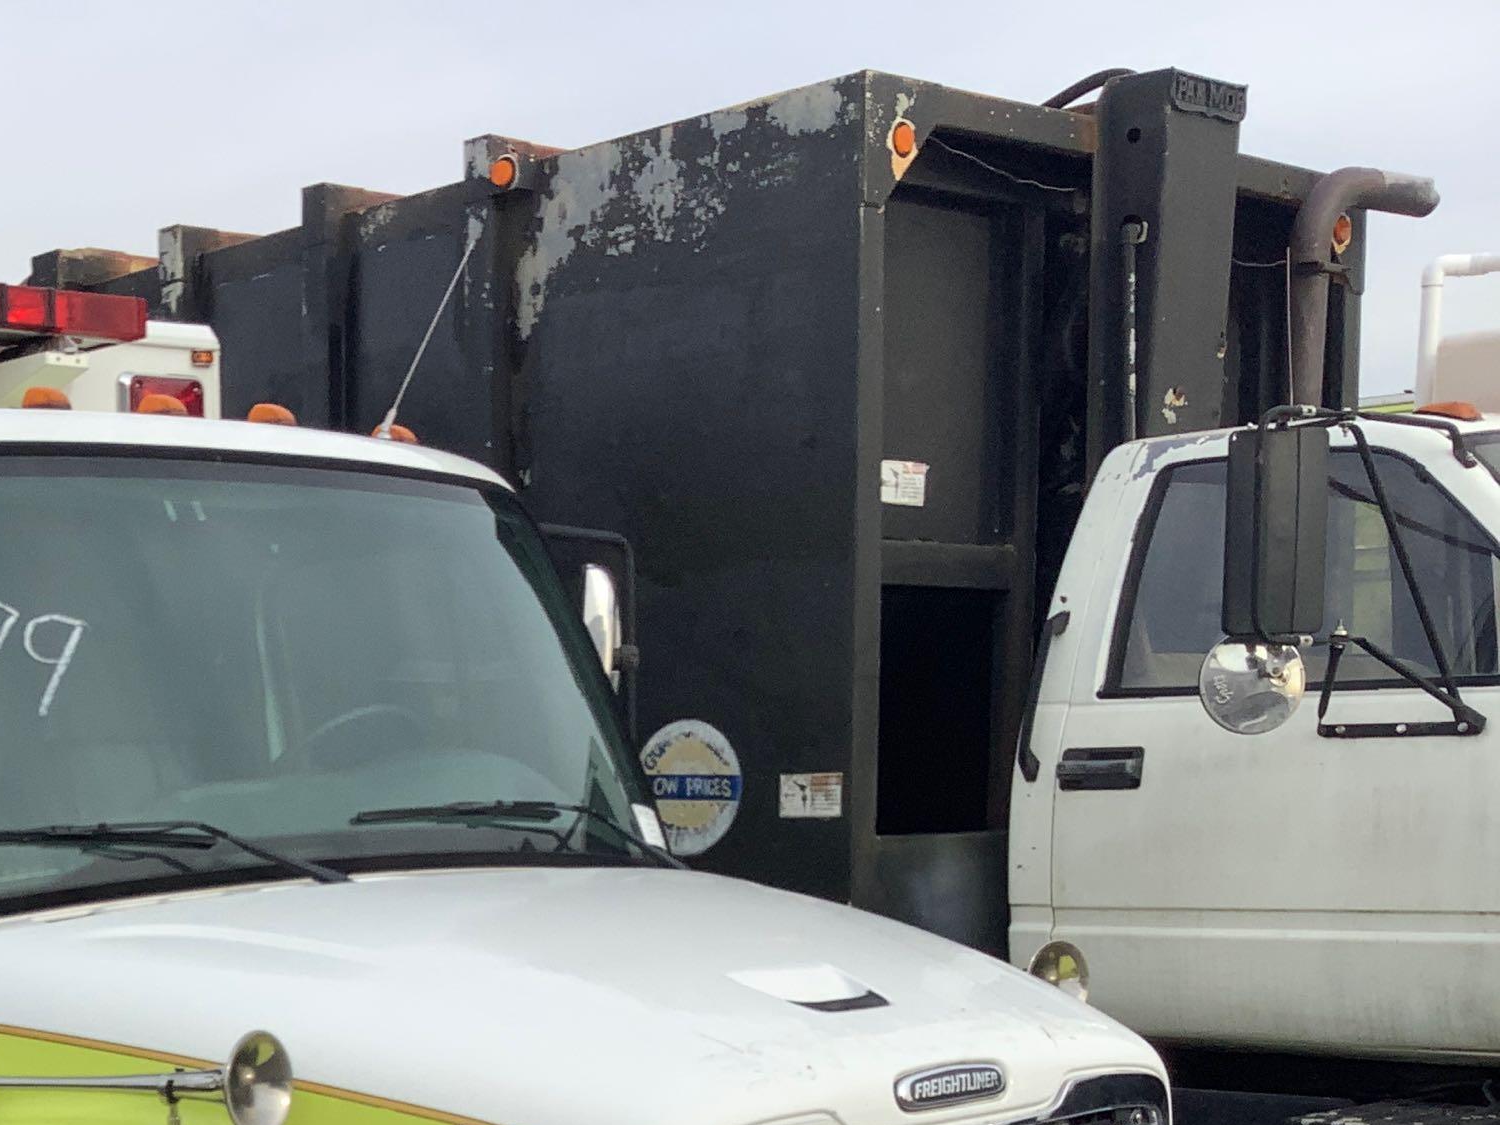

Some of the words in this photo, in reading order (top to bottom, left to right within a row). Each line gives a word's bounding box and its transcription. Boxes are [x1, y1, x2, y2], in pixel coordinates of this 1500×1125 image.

[653, 777, 678, 796] OW
[685, 777, 732, 797] PRICES
[915, 1071, 998, 1100] FREIGHTLINER
